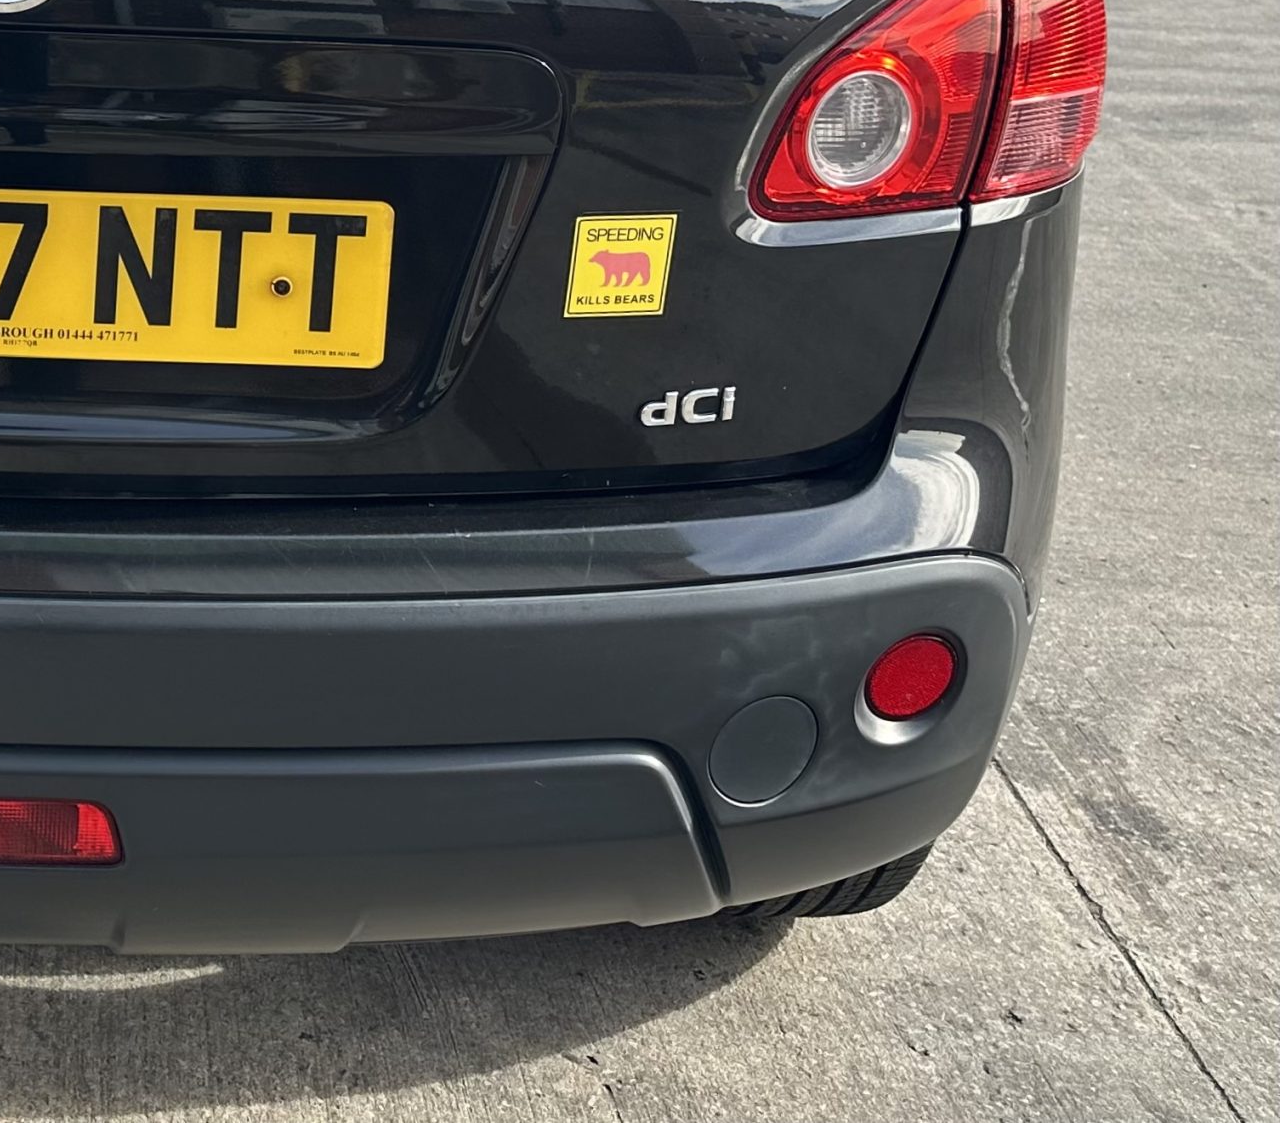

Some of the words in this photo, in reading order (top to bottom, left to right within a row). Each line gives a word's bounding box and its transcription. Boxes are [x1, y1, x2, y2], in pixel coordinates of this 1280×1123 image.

[586, 226, 665, 243] SPEEDING
[93, 204, 368, 332] NTT
[576, 295, 611, 306] KILLS
[614, 293, 656, 305] BEARS
[57, 328, 93, 341] 01444
[96, 330, 139, 342] 471771
[640, 385, 737, 427] dCi
